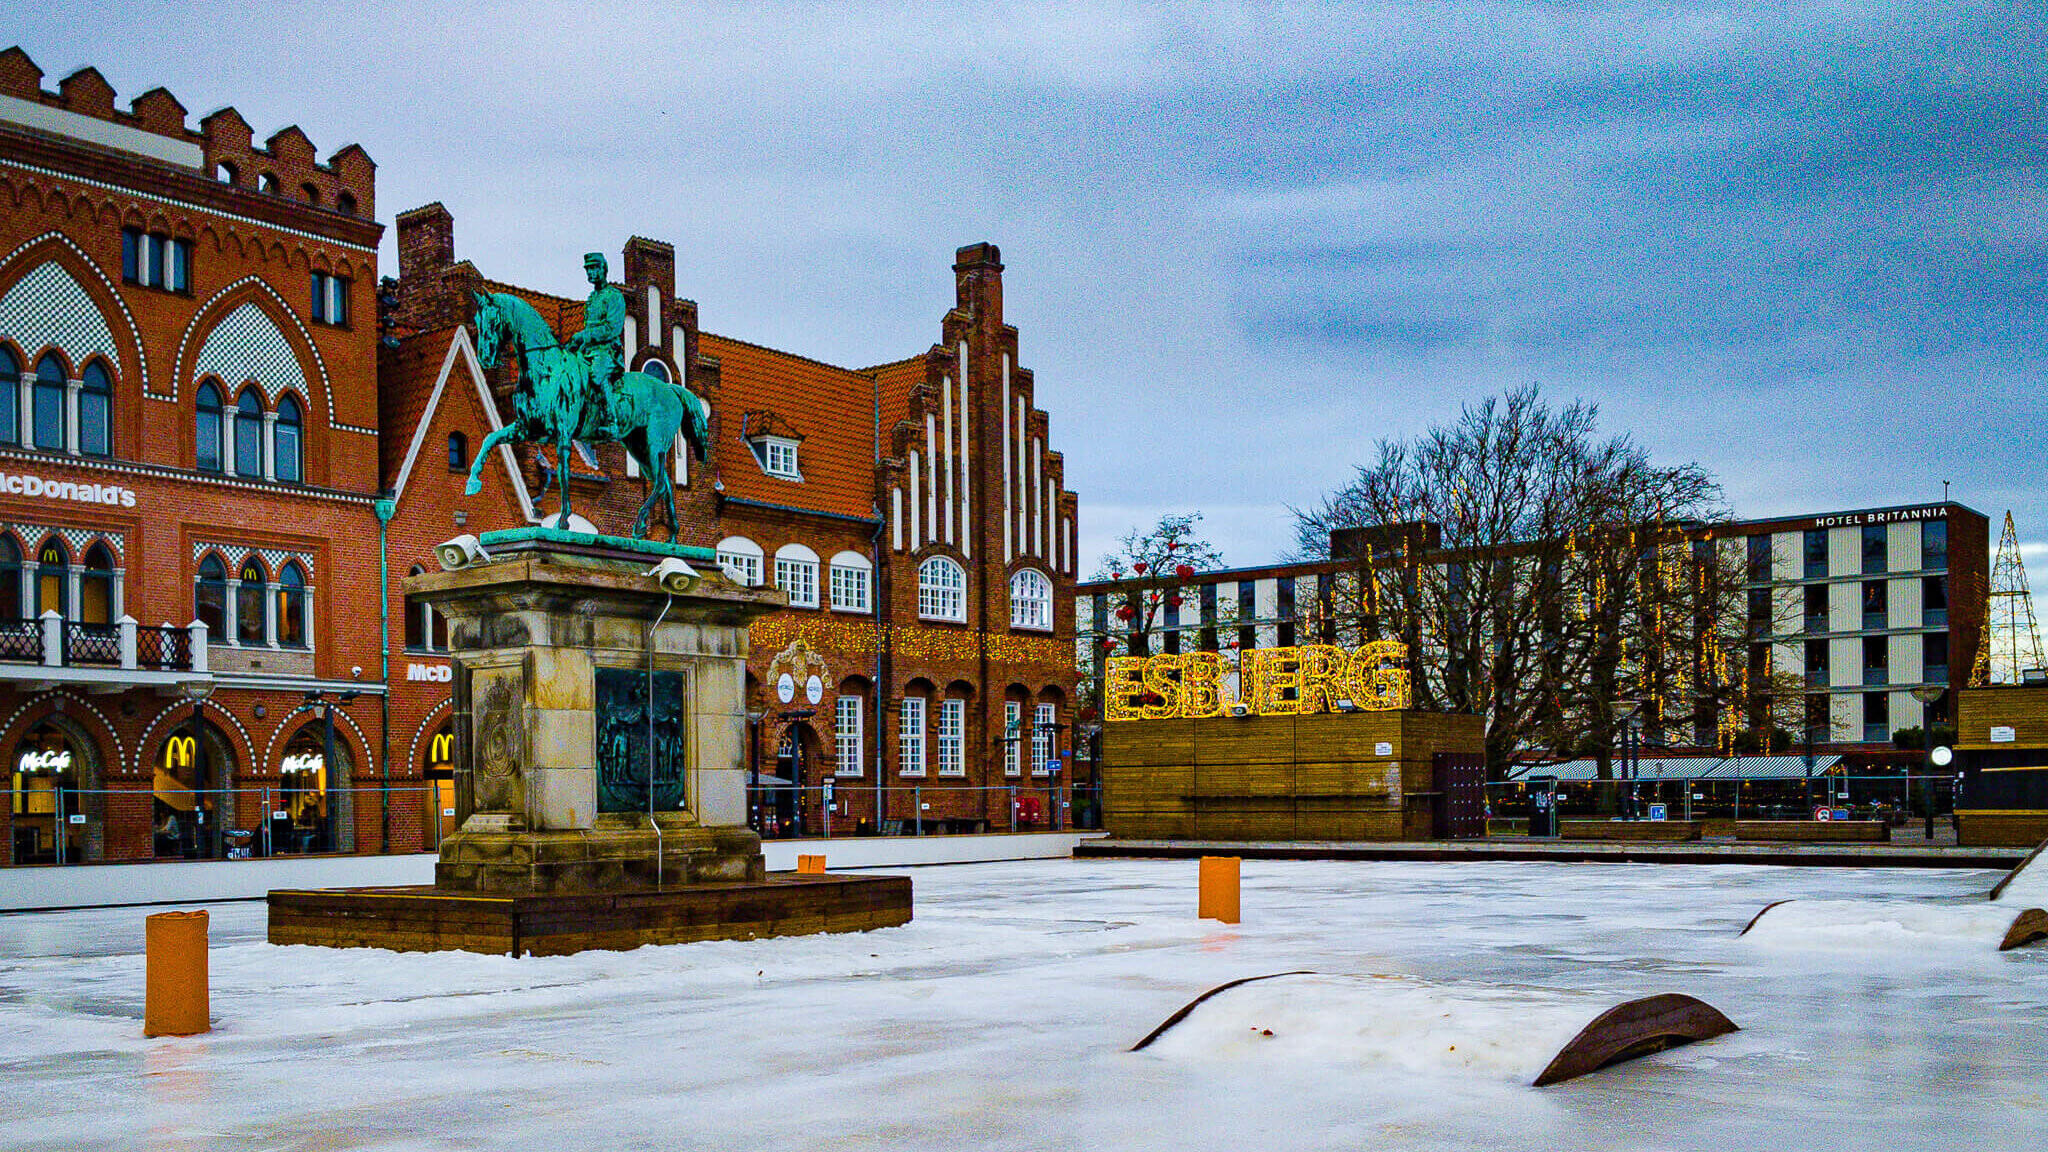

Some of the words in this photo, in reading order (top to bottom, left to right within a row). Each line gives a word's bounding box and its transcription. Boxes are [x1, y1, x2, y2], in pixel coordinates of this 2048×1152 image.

[1815, 514, 1862, 527] HOTEL
[1867, 507, 1948, 523] BRITANNIA
[1104, 641, 1412, 721] ESBJERG
